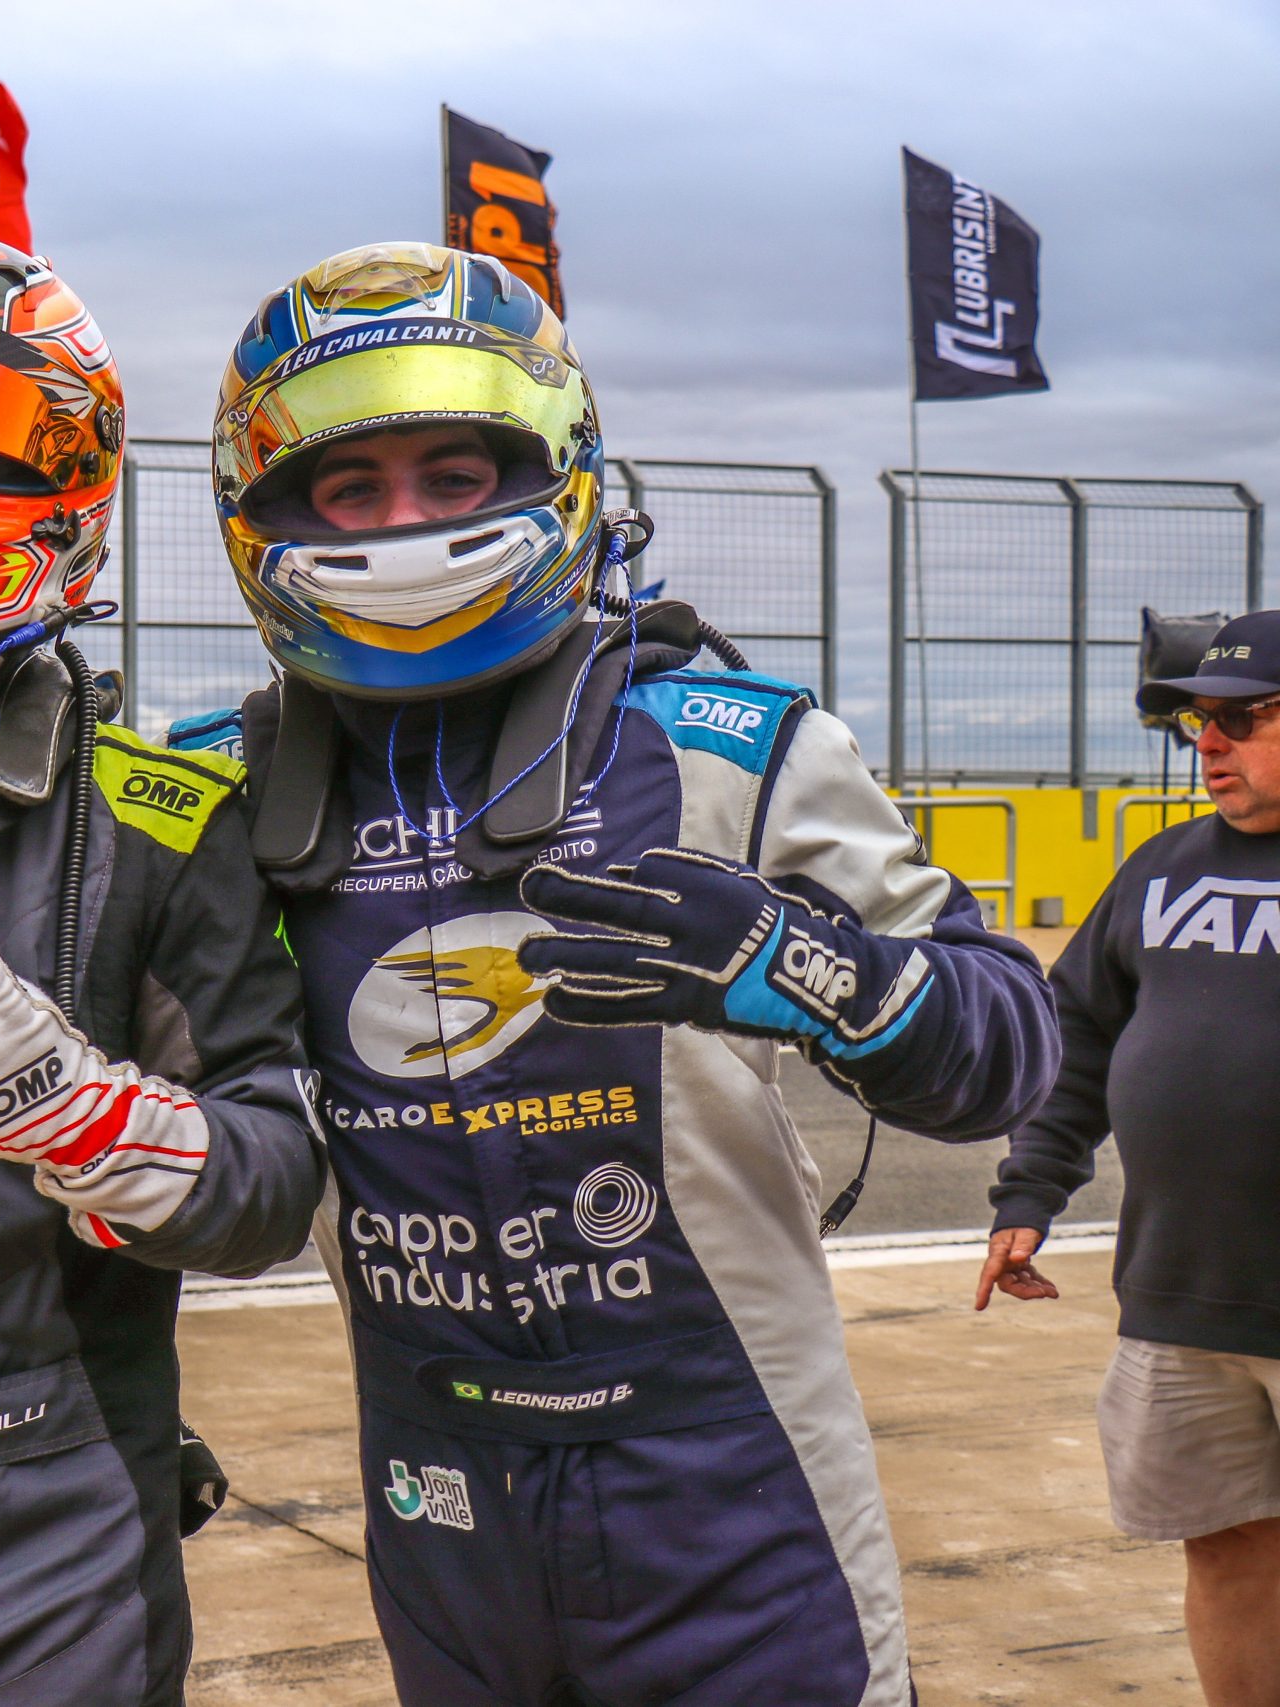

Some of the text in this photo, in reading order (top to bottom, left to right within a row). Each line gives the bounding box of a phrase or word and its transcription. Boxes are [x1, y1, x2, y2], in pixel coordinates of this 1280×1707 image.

[323, 325, 477, 357] CAVALCANTI
[681, 698, 762, 732] OMP
[123, 775, 200, 812] OMP
[533, 840, 596, 867] EDITO
[783, 940, 856, 1006] OMP
[521, 1110, 638, 1136] LOGISTICS
[491, 1389, 609, 1412] LEONARDO
[427, 1498, 471, 1526] ville
